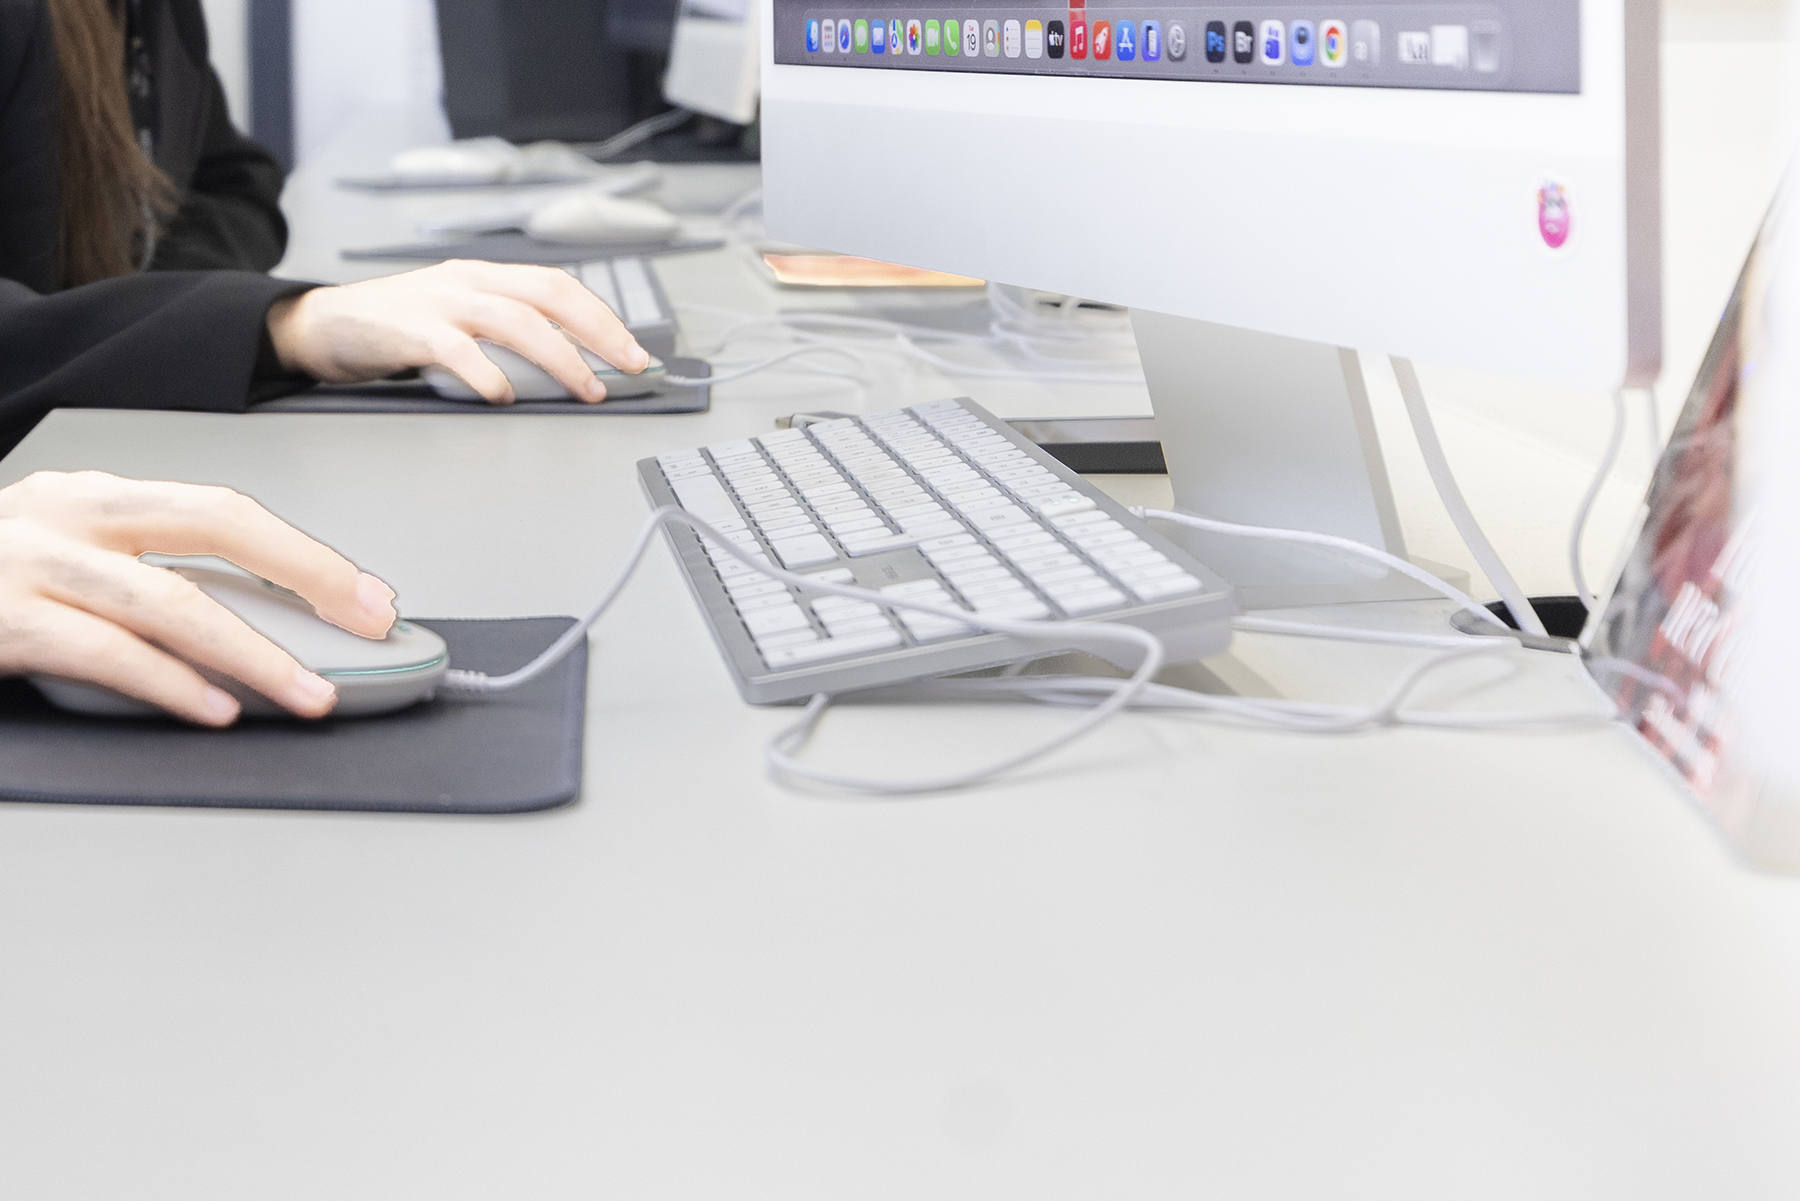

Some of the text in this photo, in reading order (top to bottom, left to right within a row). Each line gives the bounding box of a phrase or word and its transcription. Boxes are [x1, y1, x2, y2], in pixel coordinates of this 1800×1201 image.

[966, 33, 977, 51] 19
[1208, 31, 1225, 52] Ps
[1235, 31, 1253, 53] Br
